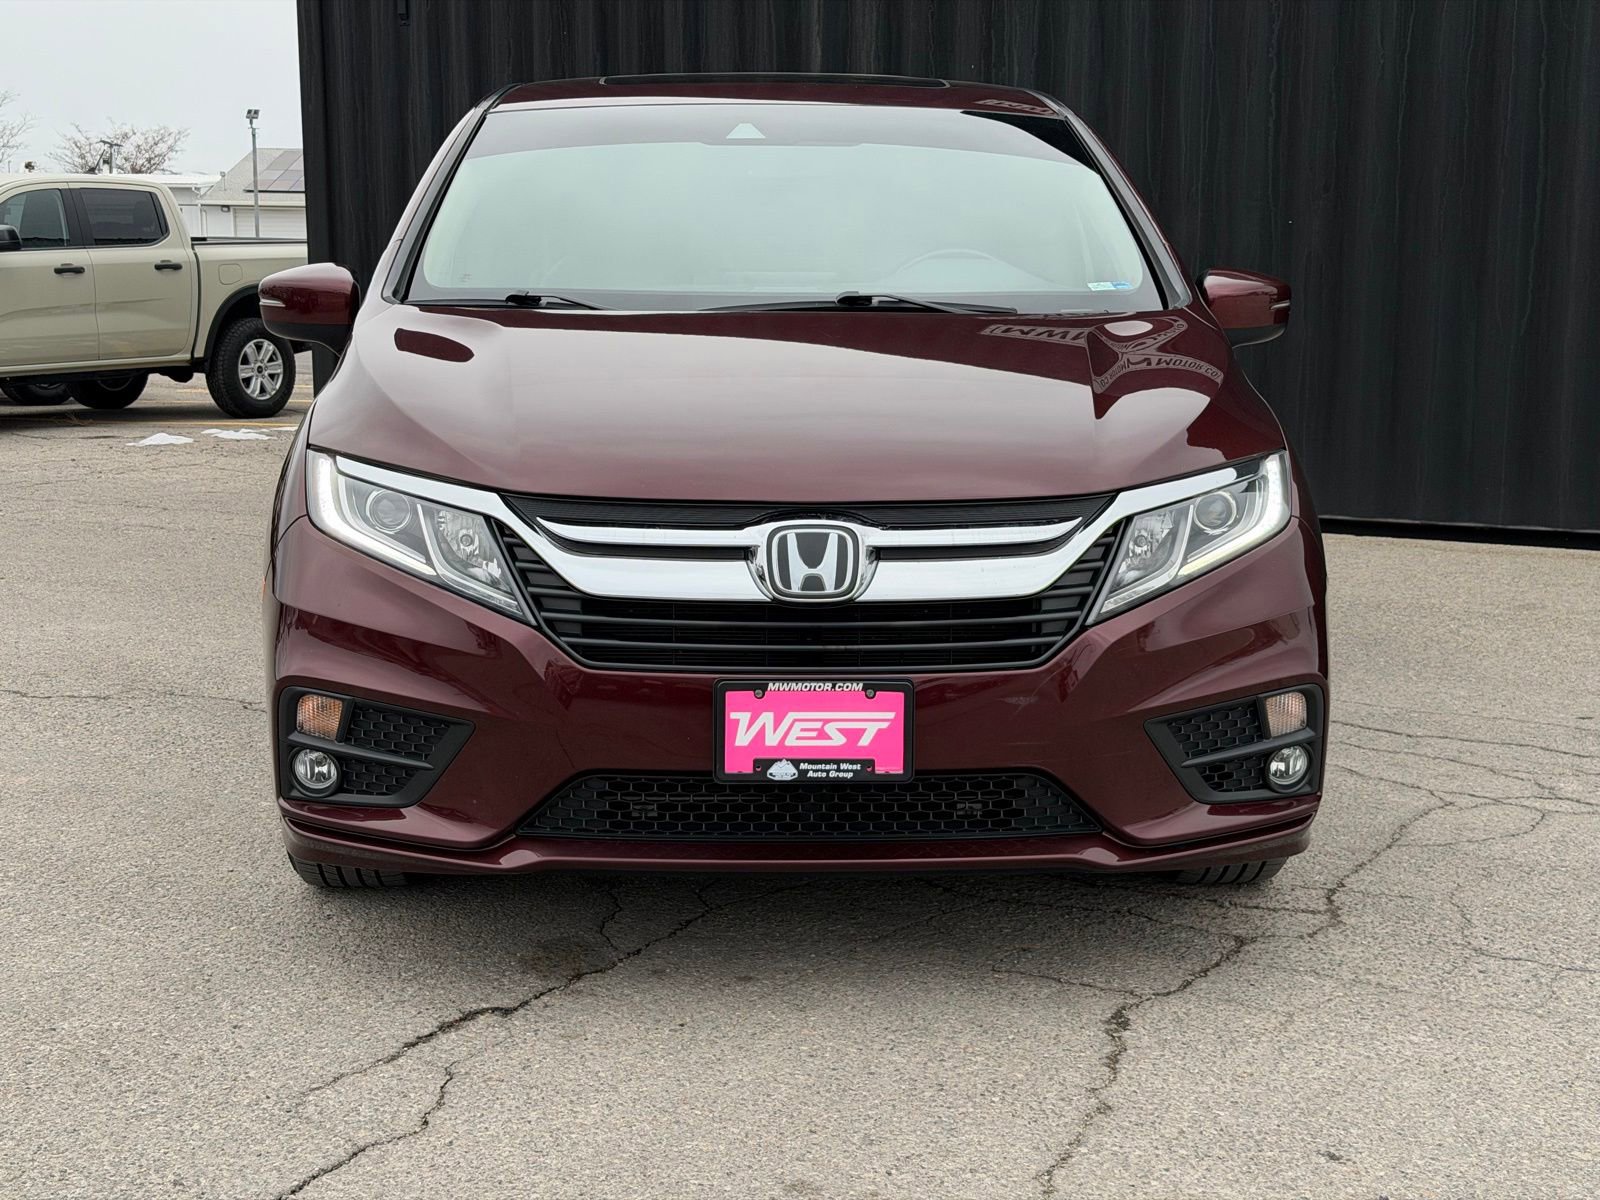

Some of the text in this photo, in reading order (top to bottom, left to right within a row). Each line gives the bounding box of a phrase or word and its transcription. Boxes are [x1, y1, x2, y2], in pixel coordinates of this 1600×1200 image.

[767, 682, 864, 692] MWMOTOR.COM
[730, 711, 896, 747] WEST
[799, 762, 861, 770] Mountain West
[807, 770, 854, 779] Auto Group
